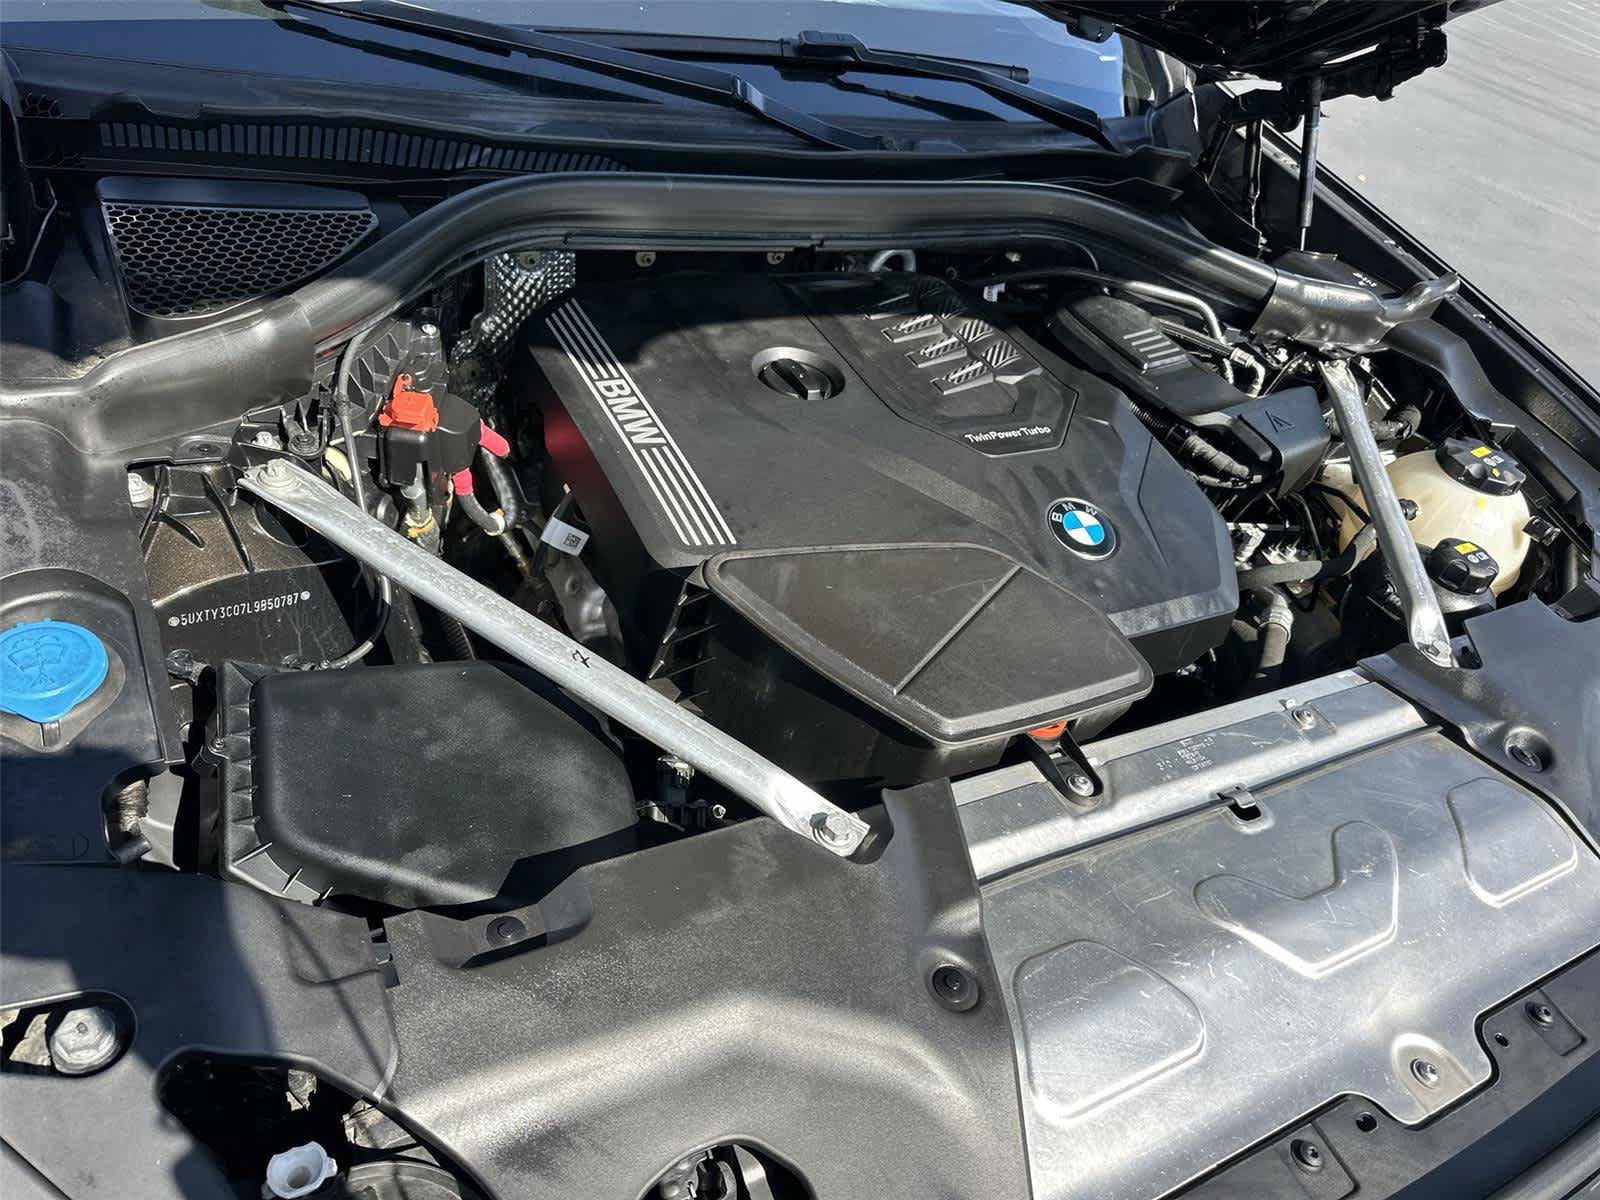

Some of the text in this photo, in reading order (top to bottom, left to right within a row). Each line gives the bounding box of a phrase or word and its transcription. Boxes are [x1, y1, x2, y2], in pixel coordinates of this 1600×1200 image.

[594, 378, 667, 444] BMW
[1051, 502, 1098, 523] BMW
[180, 592, 299, 626] 5UXTY3C07L9B50787
